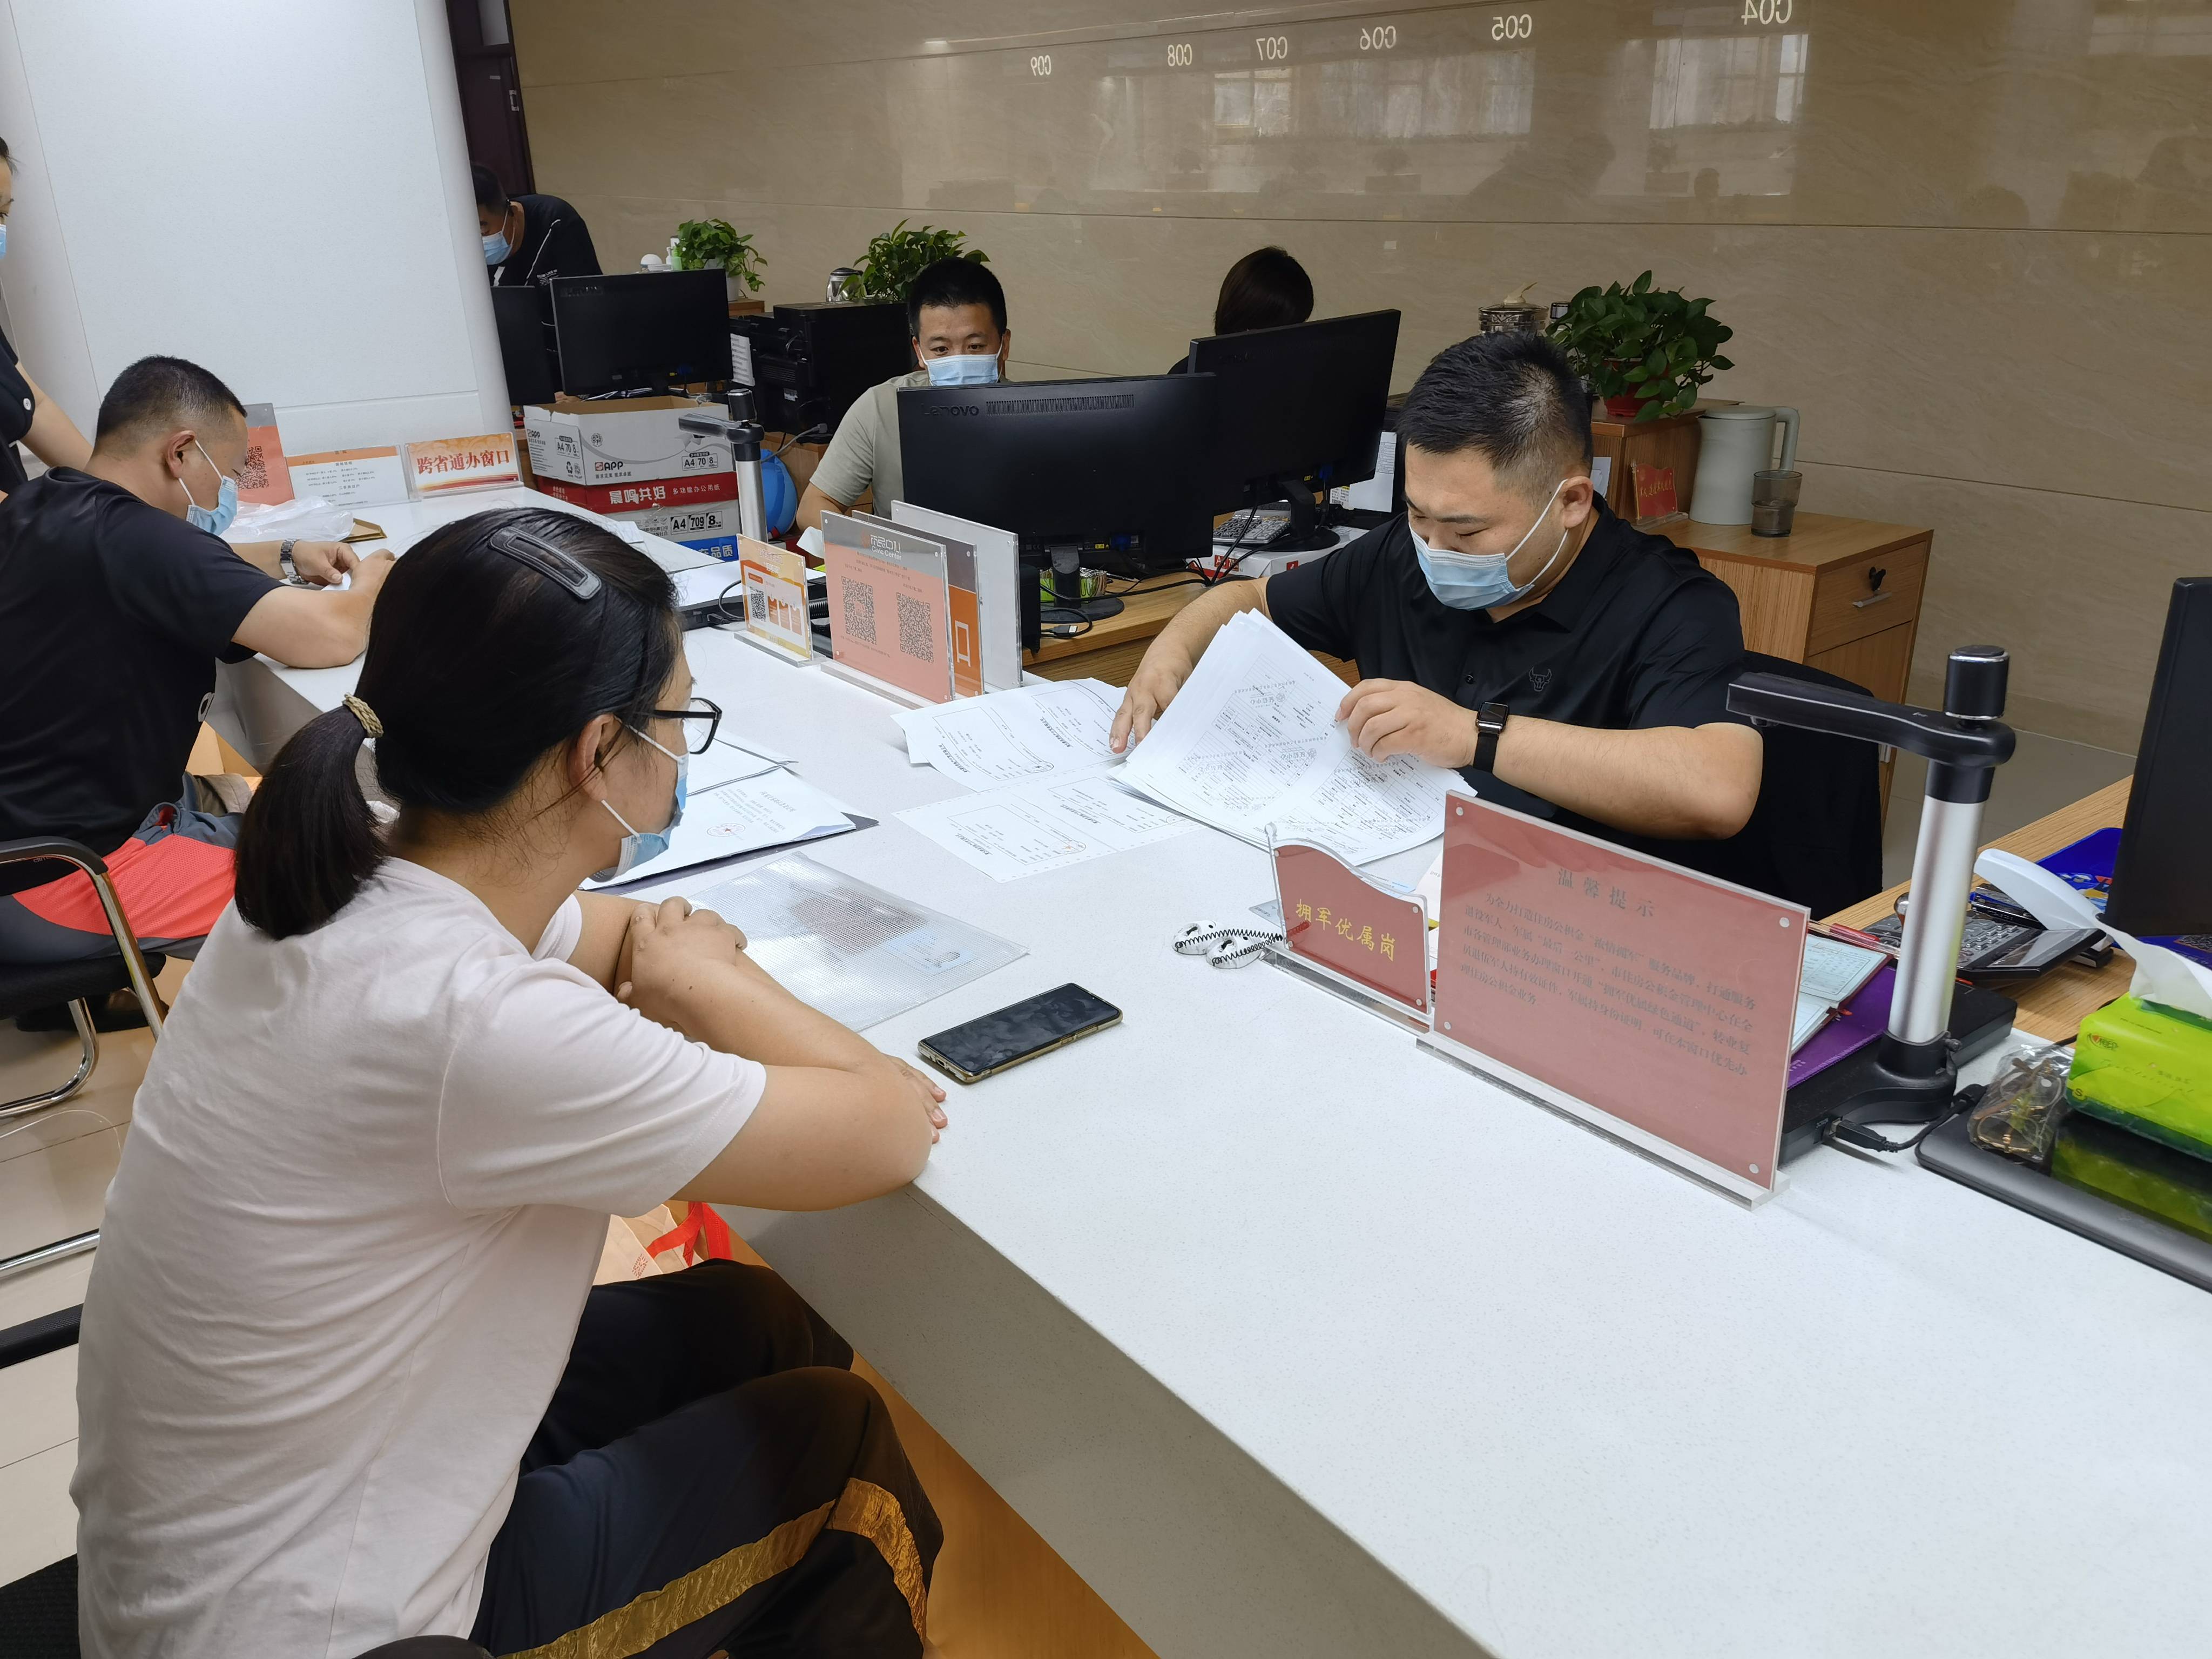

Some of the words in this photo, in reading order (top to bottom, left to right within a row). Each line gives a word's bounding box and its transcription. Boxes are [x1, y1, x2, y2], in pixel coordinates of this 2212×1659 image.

[557, 442, 564, 451] A4
[565, 443, 571, 453] 70
[416, 450, 509, 475] 跨省通办窗口
[604, 461, 623, 471] APP
[684, 459, 695, 467] A4
[697, 457, 706, 466] 70
[673, 484, 721, 495] 多功能办公用纸
[673, 518, 686, 530] A4
[871, 545, 884, 555] Civic
[885, 550, 902, 561] Center
[1558, 867, 1655, 918] 温馨提示
[1296, 898, 1395, 962] 拥军优属岗
